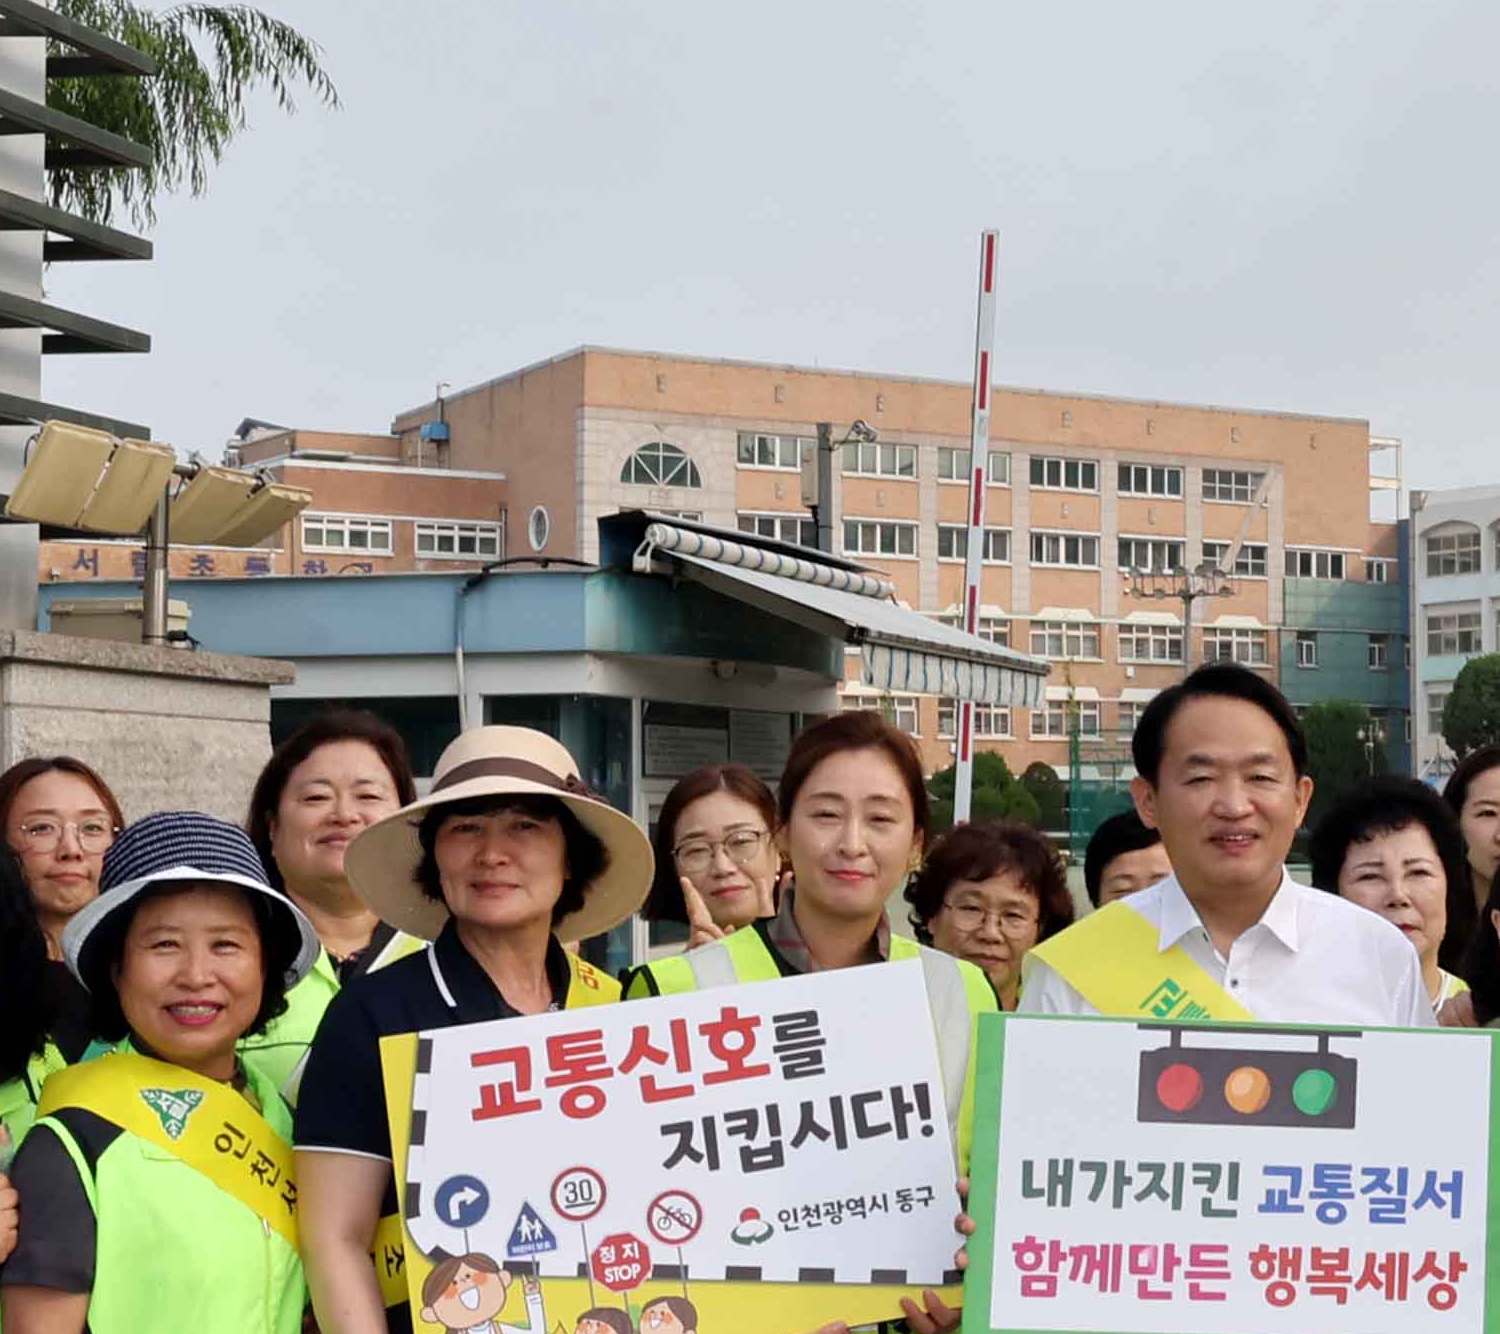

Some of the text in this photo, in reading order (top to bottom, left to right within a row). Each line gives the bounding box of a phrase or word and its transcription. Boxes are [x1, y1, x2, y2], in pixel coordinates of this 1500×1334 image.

[469, 1005, 827, 1122] 교통신호를
[658, 1082, 936, 1174] 지킵시다!
[563, 1178, 594, 1204] 30
[777, 1185, 937, 1232] 인천광역시 동구
[1021, 1158, 1465, 1225] 내가지킨 교통질서
[603, 1263, 641, 1283] STOP
[1011, 1235, 1469, 1311] 함께만든 행복세상
